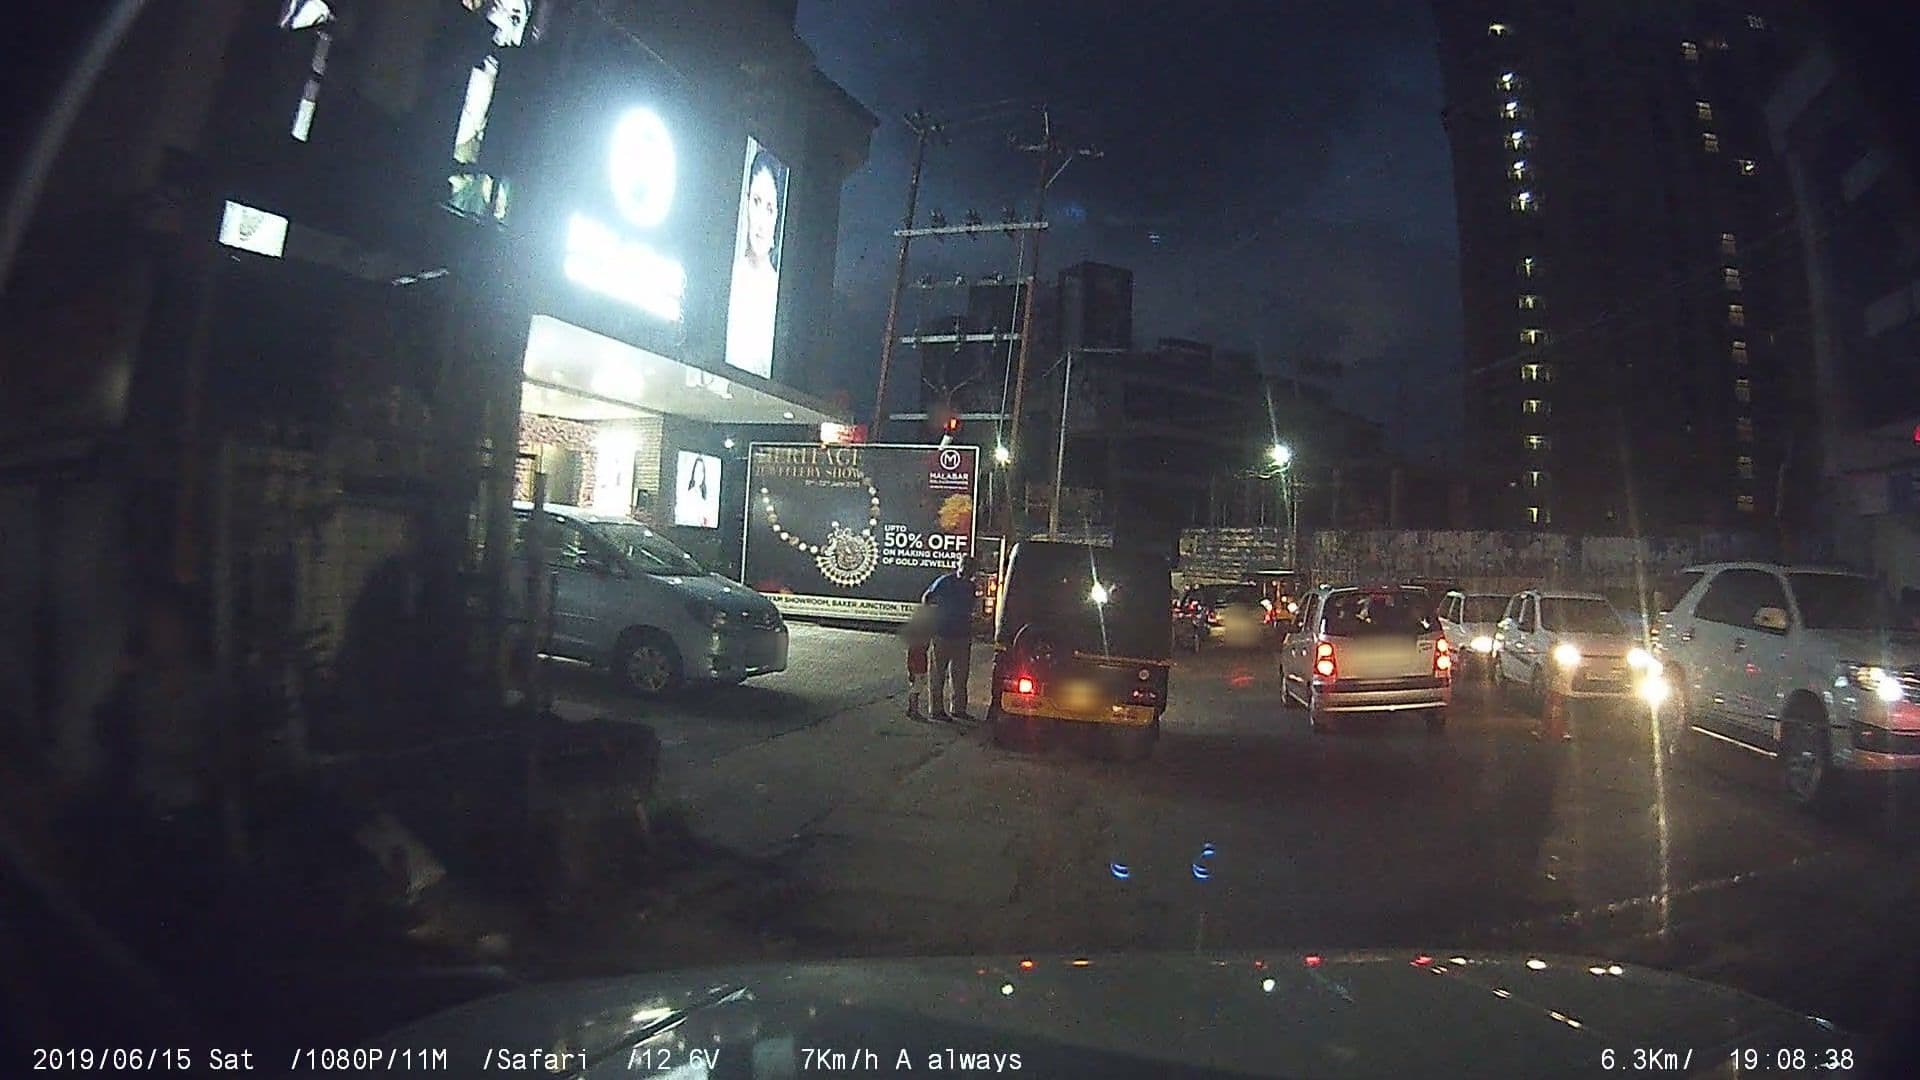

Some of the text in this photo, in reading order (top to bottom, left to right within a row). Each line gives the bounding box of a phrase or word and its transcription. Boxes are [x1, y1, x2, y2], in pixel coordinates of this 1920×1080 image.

[929, 472, 969, 480] MALABAR
[884, 525, 907, 533] UPTO
[884, 532, 968, 551] 50% OFF
[882, 548, 896, 556] ON
[897, 549, 931, 558] MAKING
[882, 557, 894, 565] OF
[895, 558, 918, 566] GOLD
